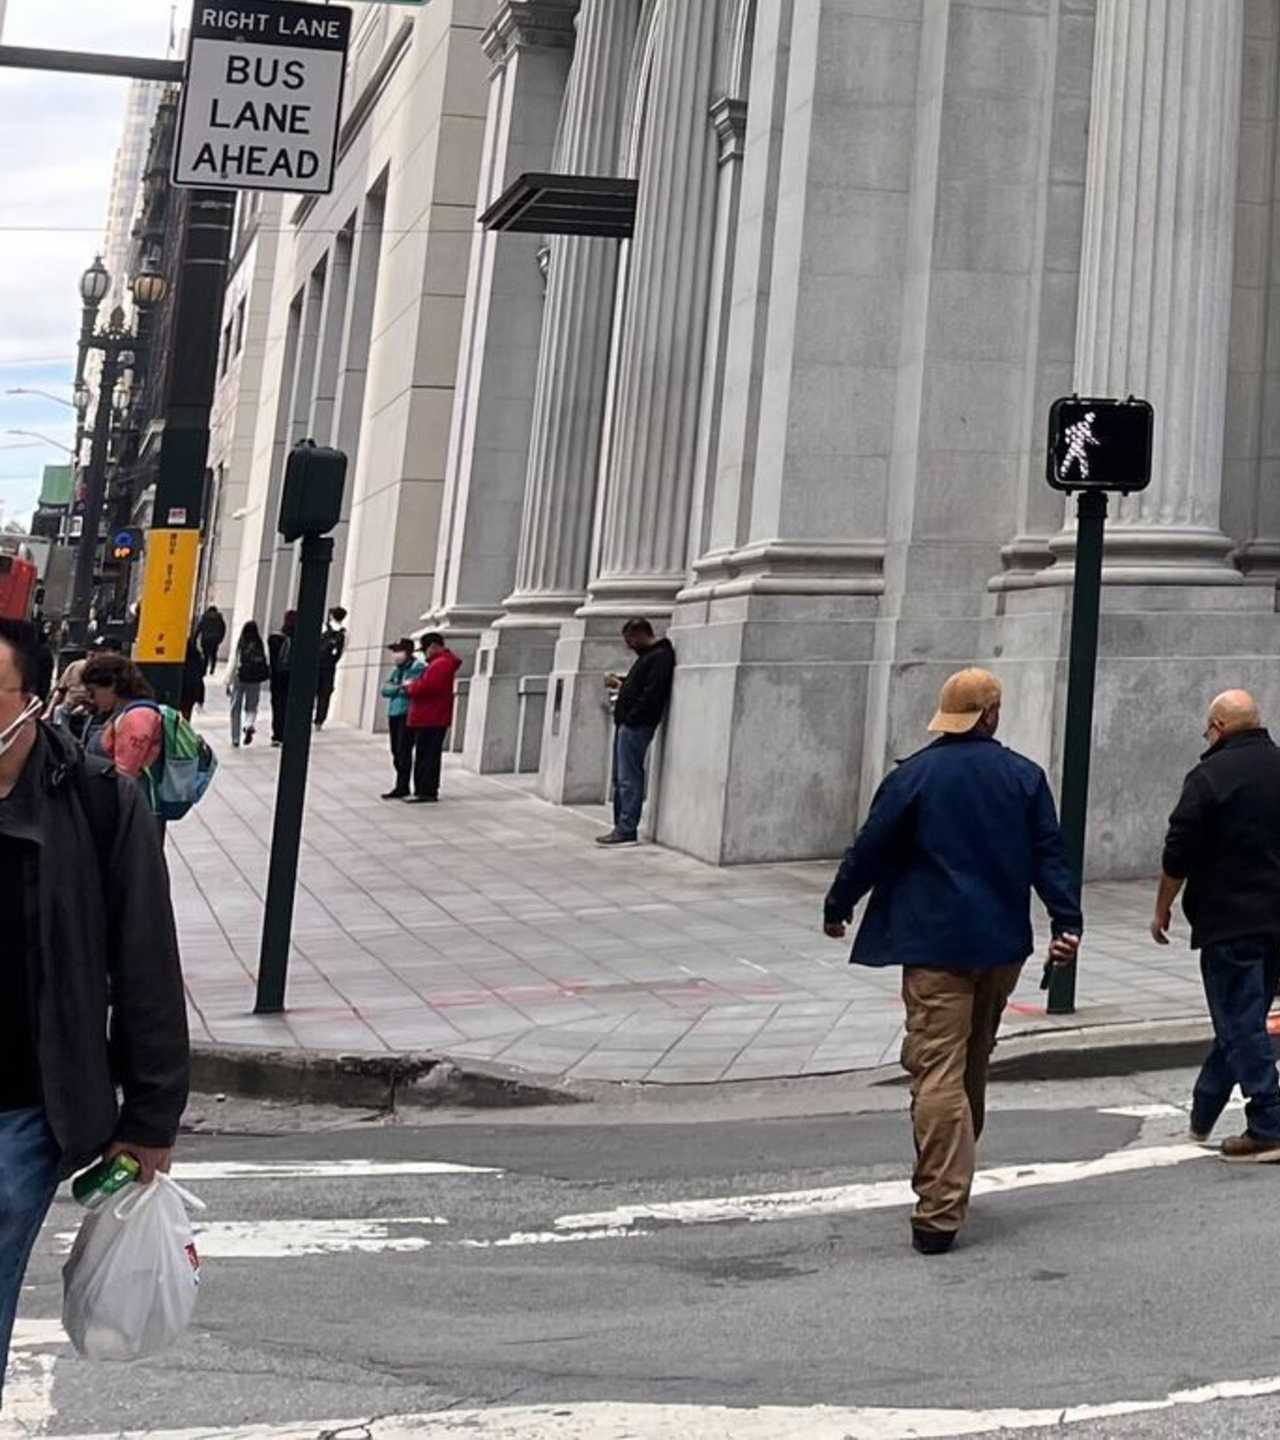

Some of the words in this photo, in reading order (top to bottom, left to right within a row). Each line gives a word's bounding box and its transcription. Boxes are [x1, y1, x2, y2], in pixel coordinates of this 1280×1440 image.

[201, 8, 270, 32] RIGHT
[278, 16, 340, 39] LANE
[225, 55, 305, 90] BUS
[209, 99, 311, 135] LANE
[192, 143, 319, 179] AHEAD
